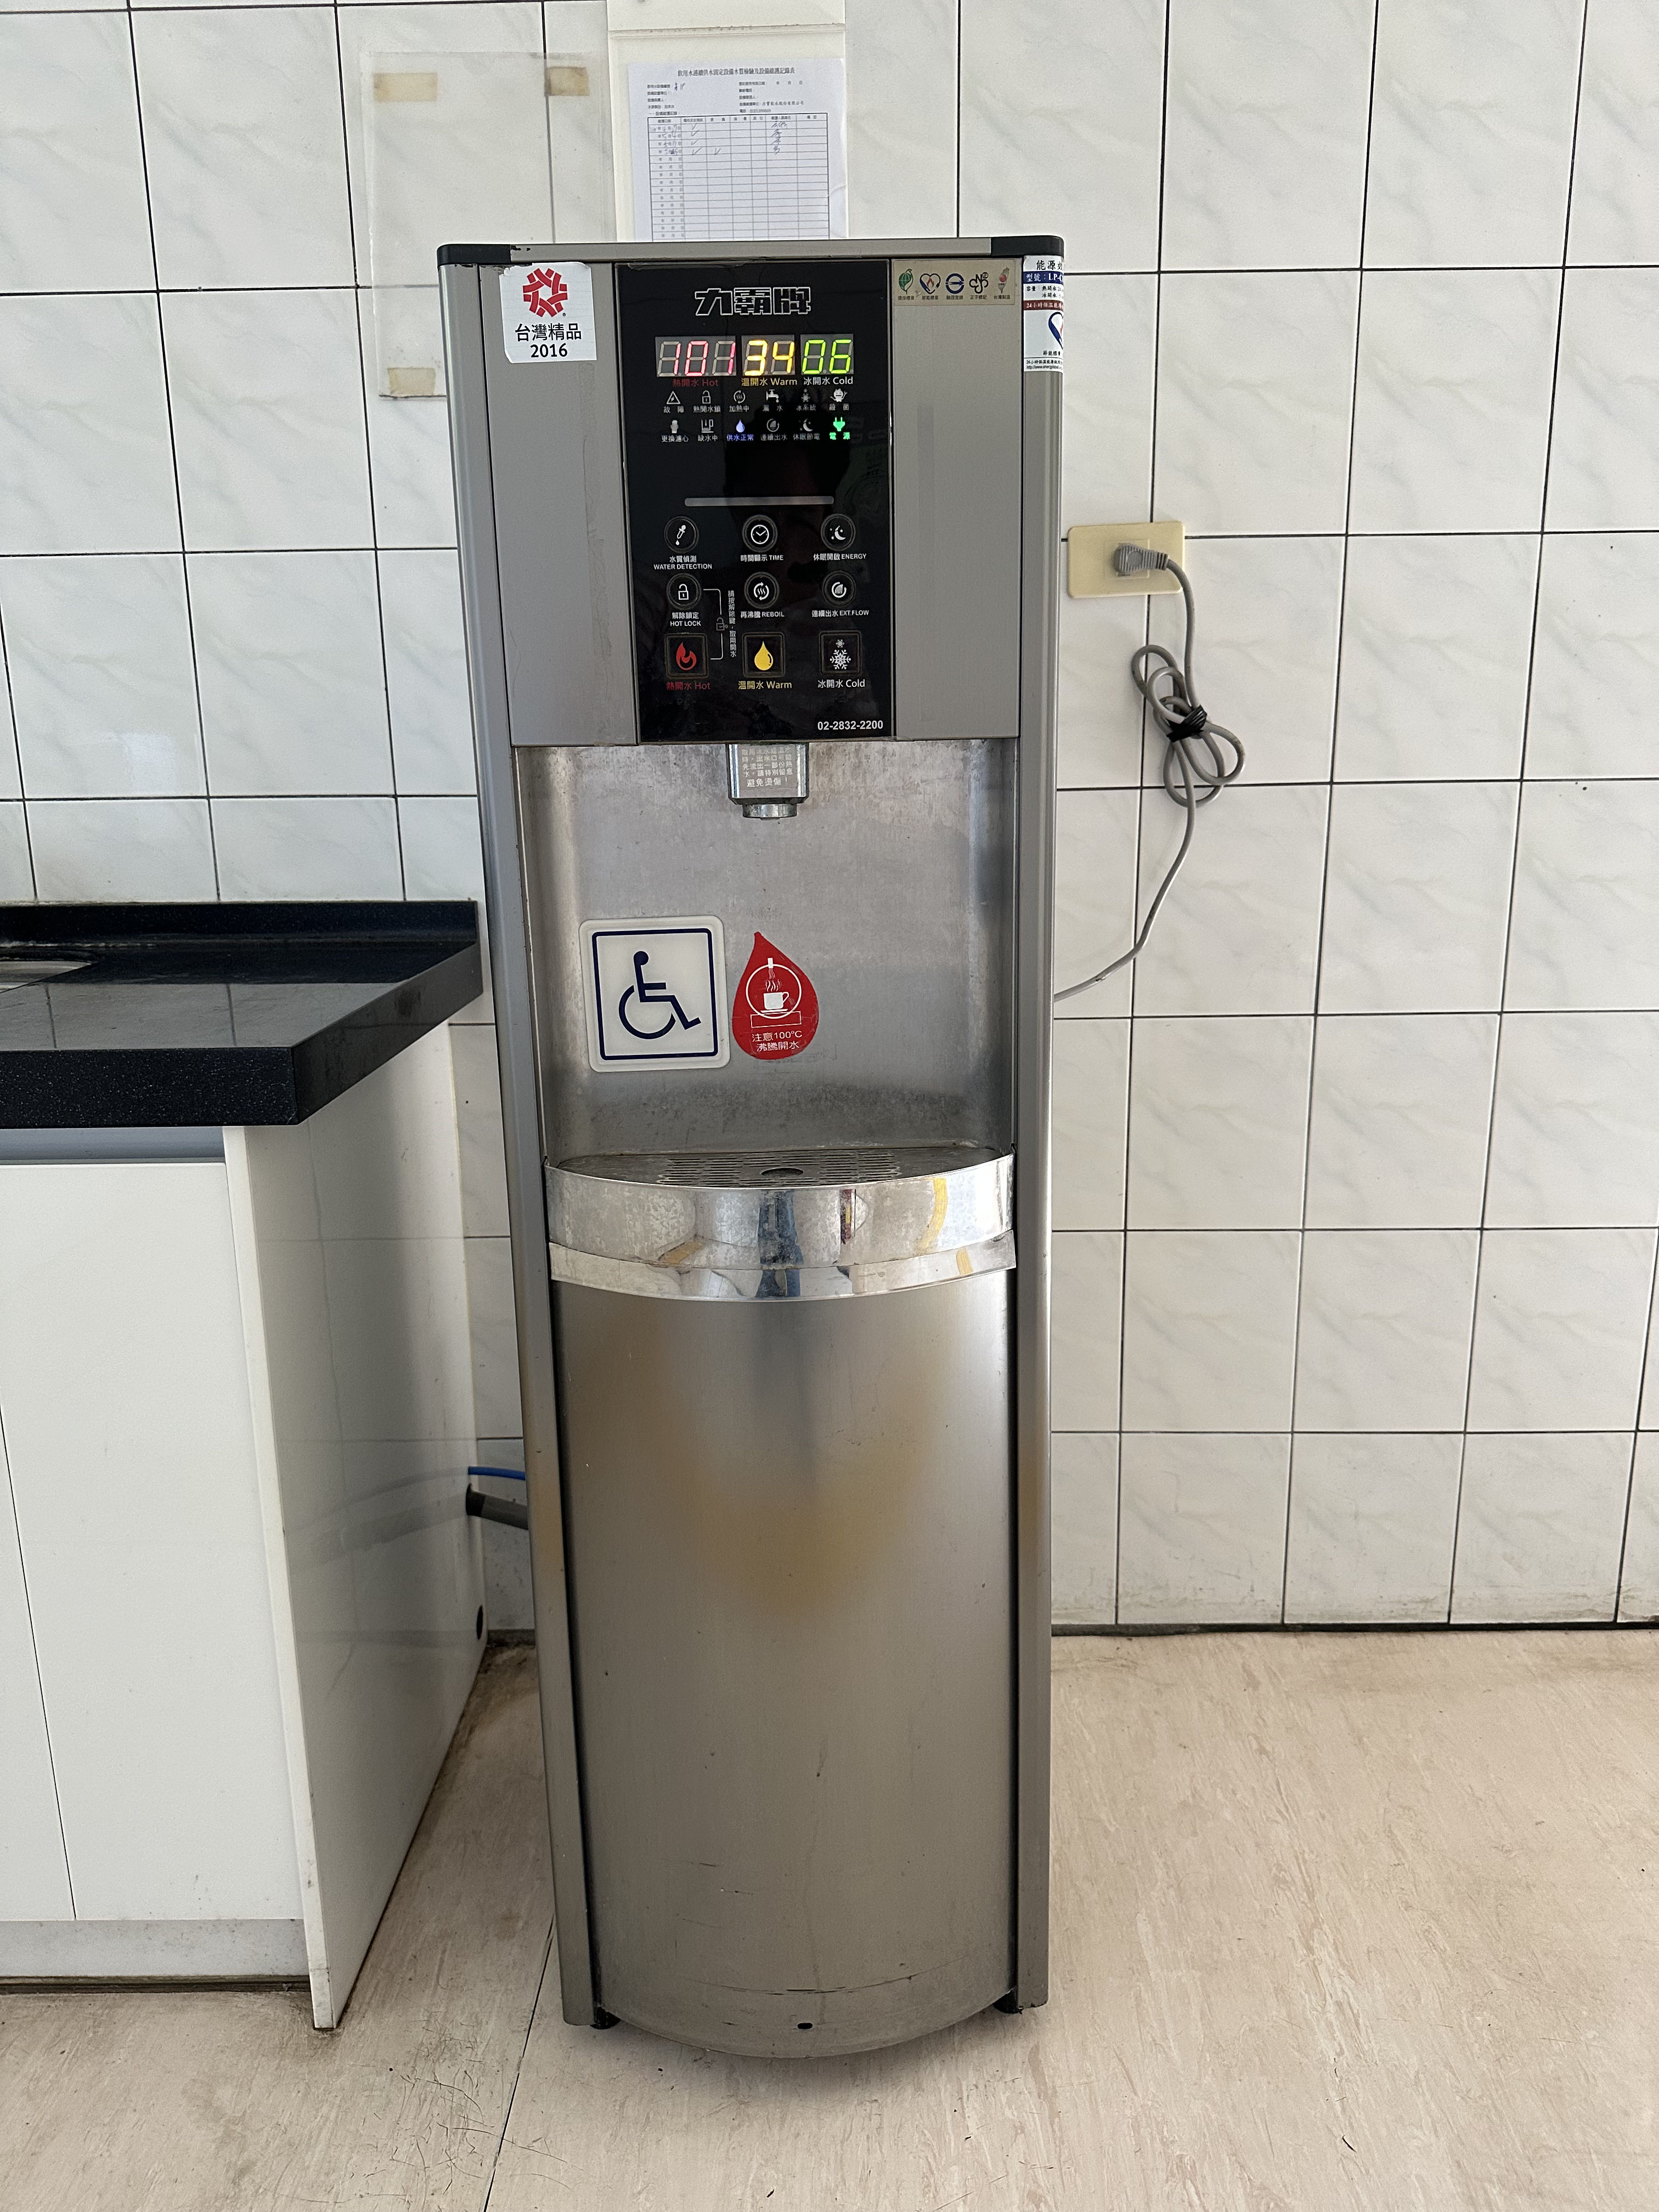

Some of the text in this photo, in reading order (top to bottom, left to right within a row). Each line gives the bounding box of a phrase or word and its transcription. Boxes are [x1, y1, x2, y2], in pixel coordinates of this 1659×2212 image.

[695, 286, 811, 317] 力霸牌
[515, 323, 582, 341] 台灣精品
[530, 343, 568, 358] 2016
[674, 339, 852, 376] 101 34 06
[741, 378, 768, 386] 溫開水
[803, 376, 853, 386] 冰開水 Cold
[666, 681, 711, 690] 熱開水 Hot
[738, 680, 792, 690] 溫開水 Warm
[817, 678, 865, 688] 冰開水 Cold
[817, 720, 883, 730] 02-2832-2200
[756, 1041, 799, 1052] 沸騰開水
